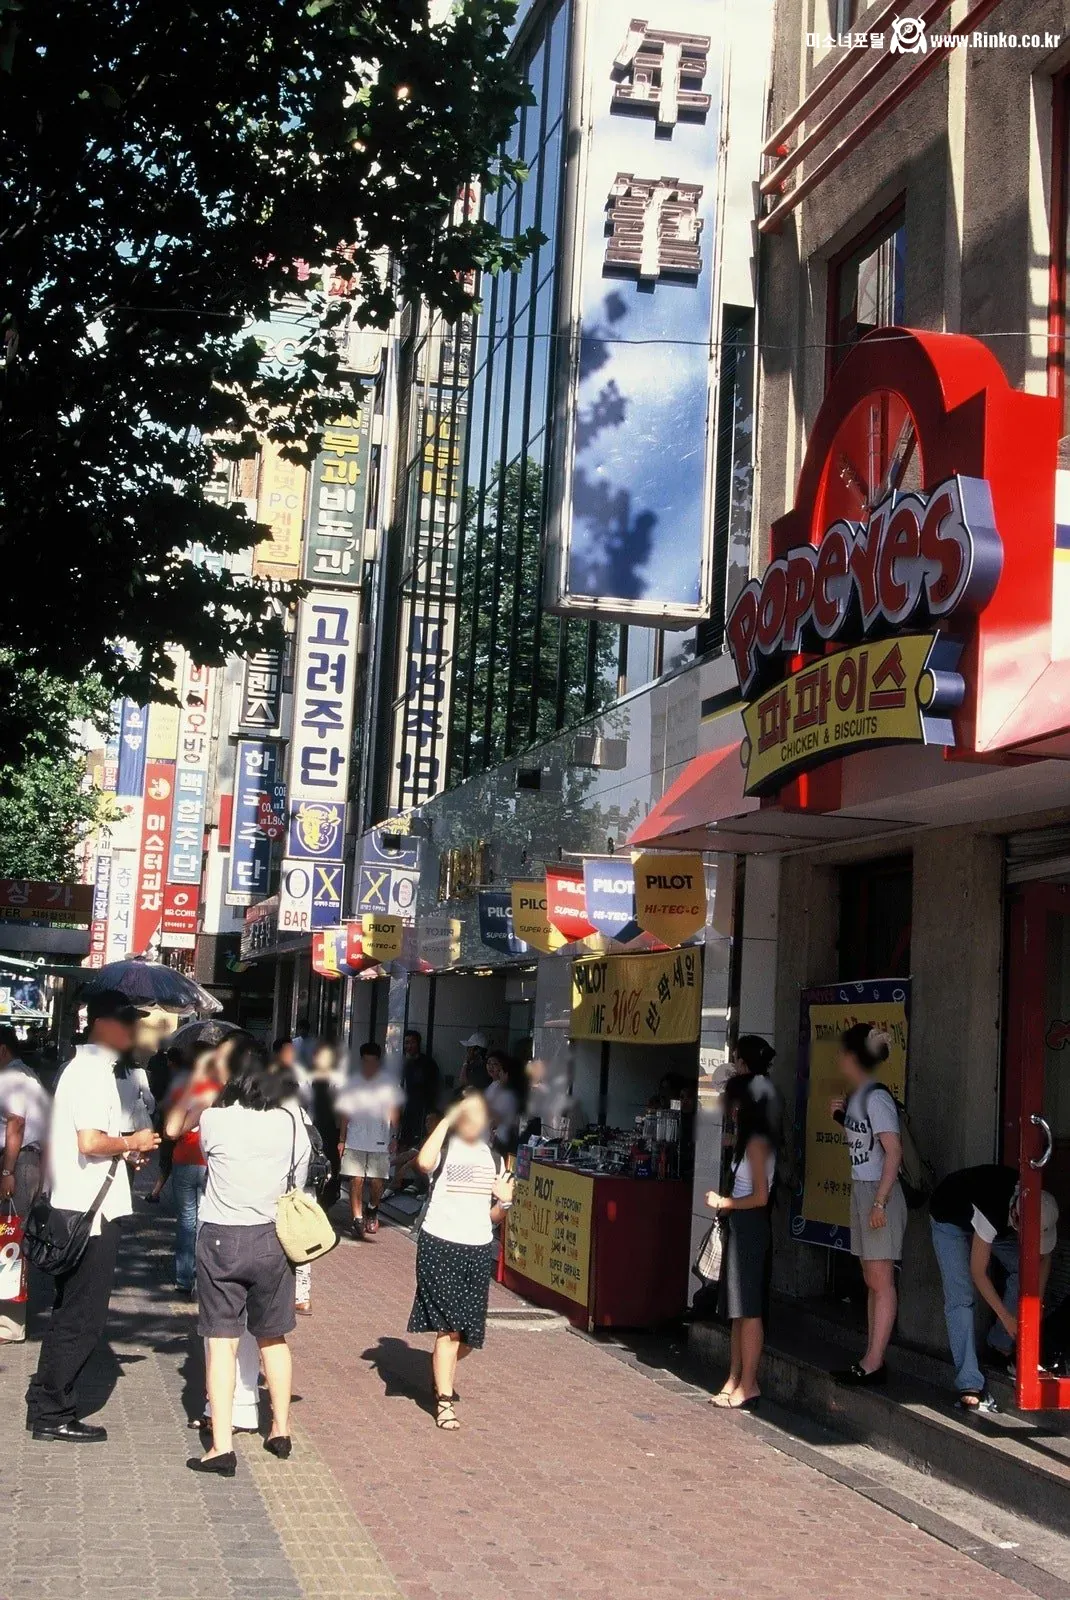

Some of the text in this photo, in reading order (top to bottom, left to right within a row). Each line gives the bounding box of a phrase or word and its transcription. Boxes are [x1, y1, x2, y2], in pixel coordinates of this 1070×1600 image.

[269, 493, 299, 510] PC
[299, 602, 350, 788] 고려주단
[758, 643, 907, 753] 파파이스
[781, 715, 878, 761] CHICKEN & BISCUITS
[173, 772, 204, 877] 백합주단
[140, 814, 165, 911] 미스터피자
[557, 880, 585, 894] PILO
[593, 878, 635, 894] PILOT
[646, 875, 693, 890] PILOT
[113, 868, 132, 952] 종로서적
[487, 907, 513, 918] PILO
[520, 898, 547, 910] PILO
[554, 906, 579, 916] SUPER
[284, 910, 308, 927] BAR
[369, 924, 396, 933] PILOT
[575, 962, 607, 994] PILOT
[534, 1176, 555, 1202] PILOT
[531, 1204, 551, 1236] SALE
